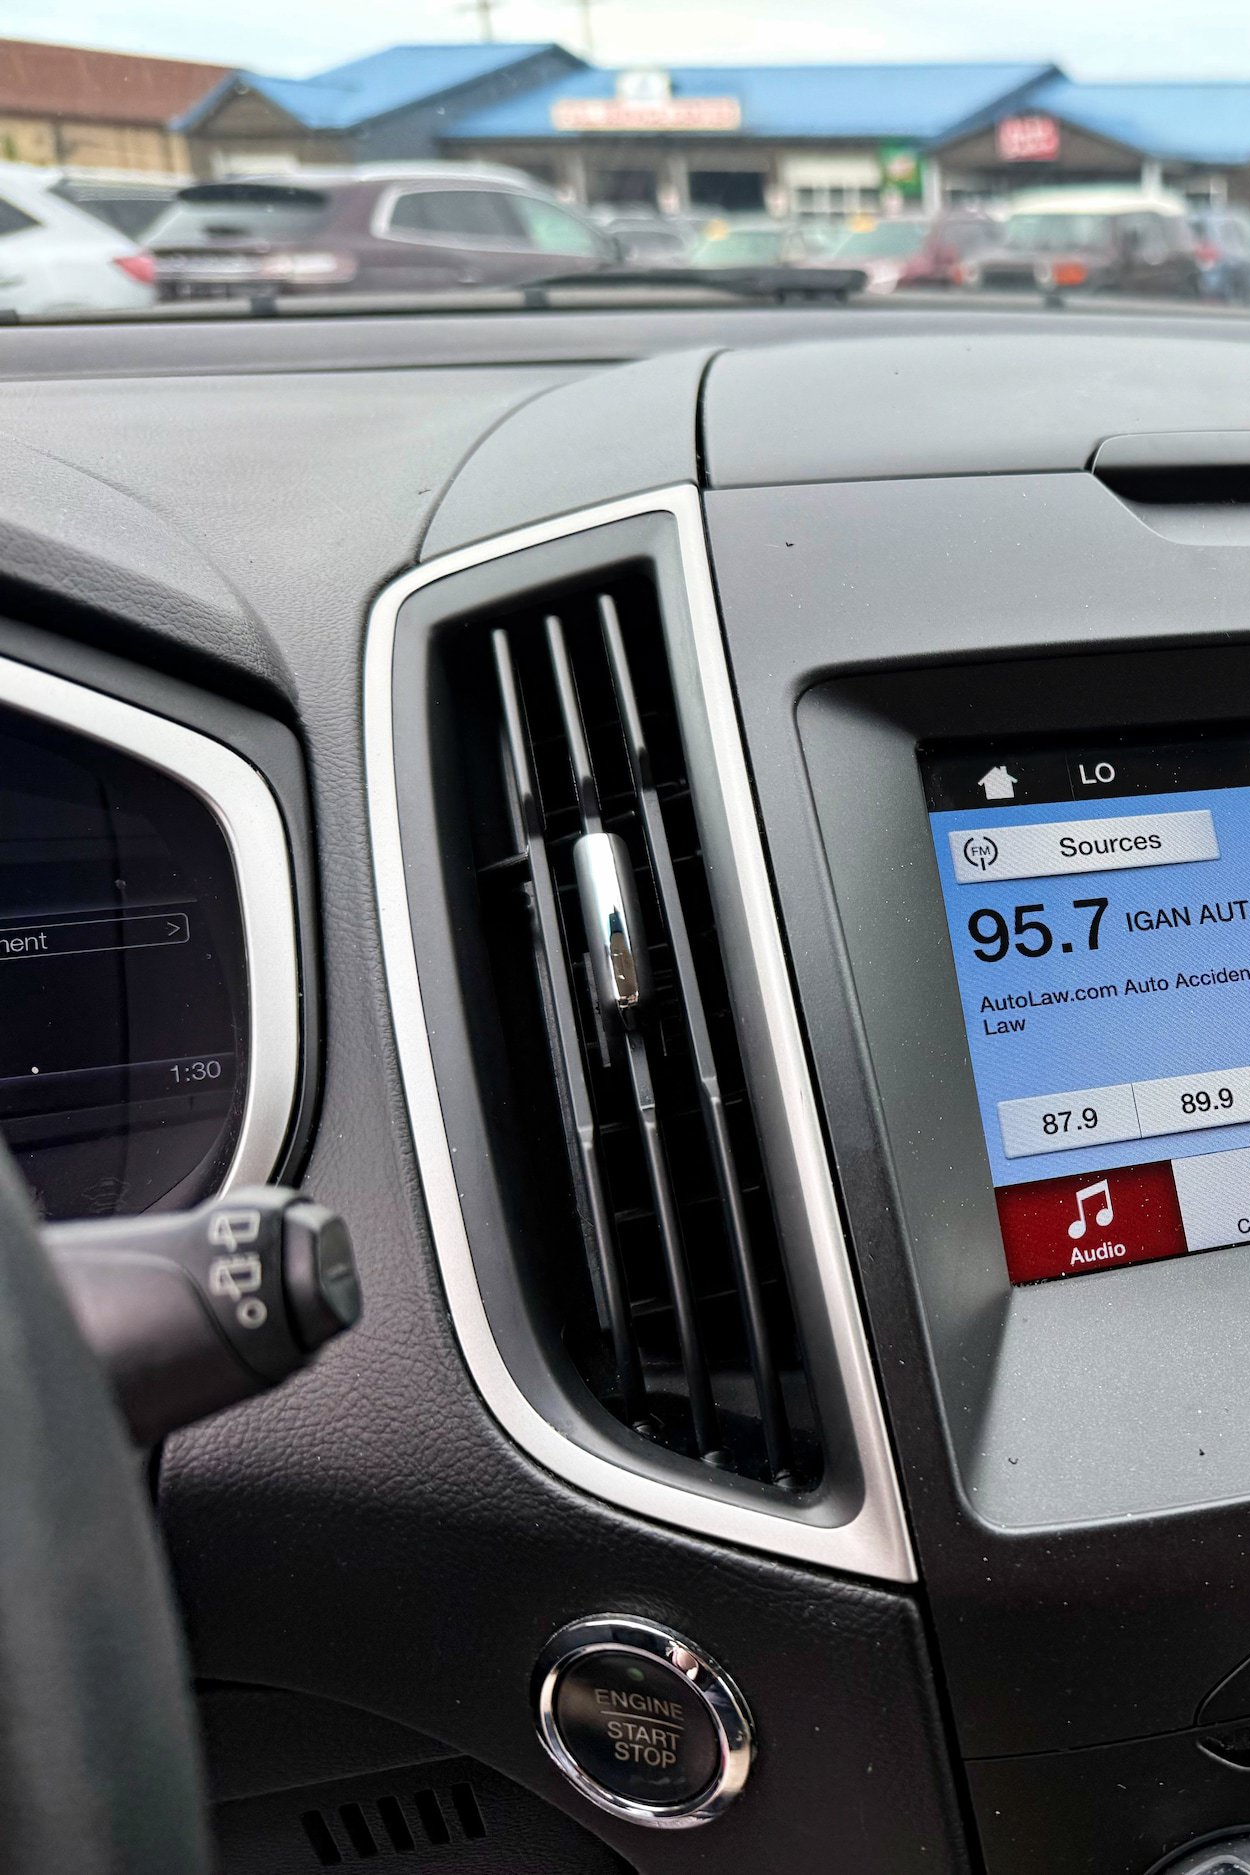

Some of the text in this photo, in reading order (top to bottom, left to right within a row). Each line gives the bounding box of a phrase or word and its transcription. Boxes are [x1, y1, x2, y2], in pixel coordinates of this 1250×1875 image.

[1079, 762, 1115, 785] LO
[971, 844, 991, 857] FM
[1059, 831, 1162, 858] Sources
[967, 897, 1249, 963] 95.7 IGAN AUT
[980, 983, 1118, 1013] AutoLaw.com
[1124, 976, 1169, 996] Auto
[984, 1016, 1026, 1036] Law
[170, 1060, 221, 1083] 1:30
[1181, 1087, 1234, 1114] 89.9
[1042, 1107, 1099, 1136] 87.9
[1070, 1239, 1126, 1265] Audio
[595, 1689, 683, 1721] ENGINE
[607, 1721, 680, 1751] START
[615, 1741, 677, 1768] STOP
